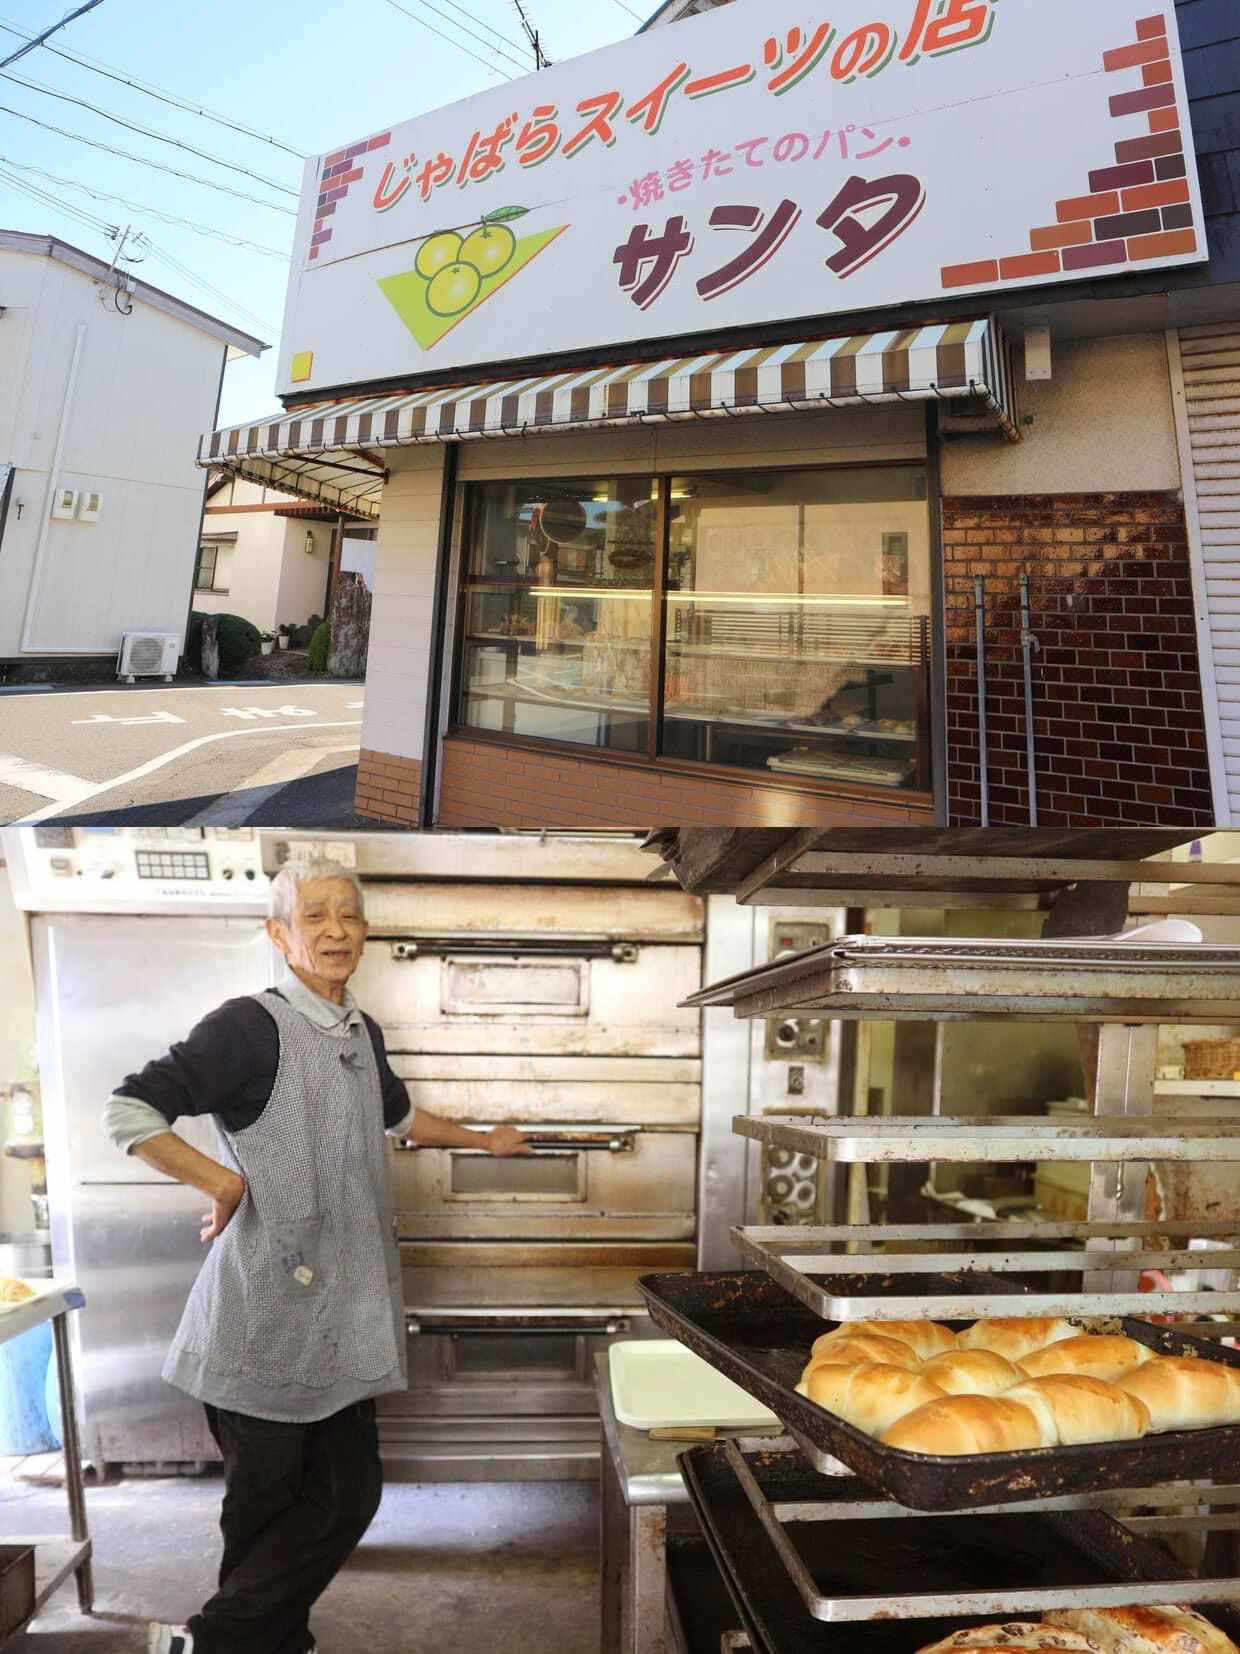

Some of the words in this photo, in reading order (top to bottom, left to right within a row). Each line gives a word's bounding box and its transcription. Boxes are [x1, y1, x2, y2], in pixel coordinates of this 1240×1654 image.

[373, 0, 997, 213] じゃばらスイーツの店
[612, 173, 926, 311] サンタ
[71, 701, 364, 725] 止ま
